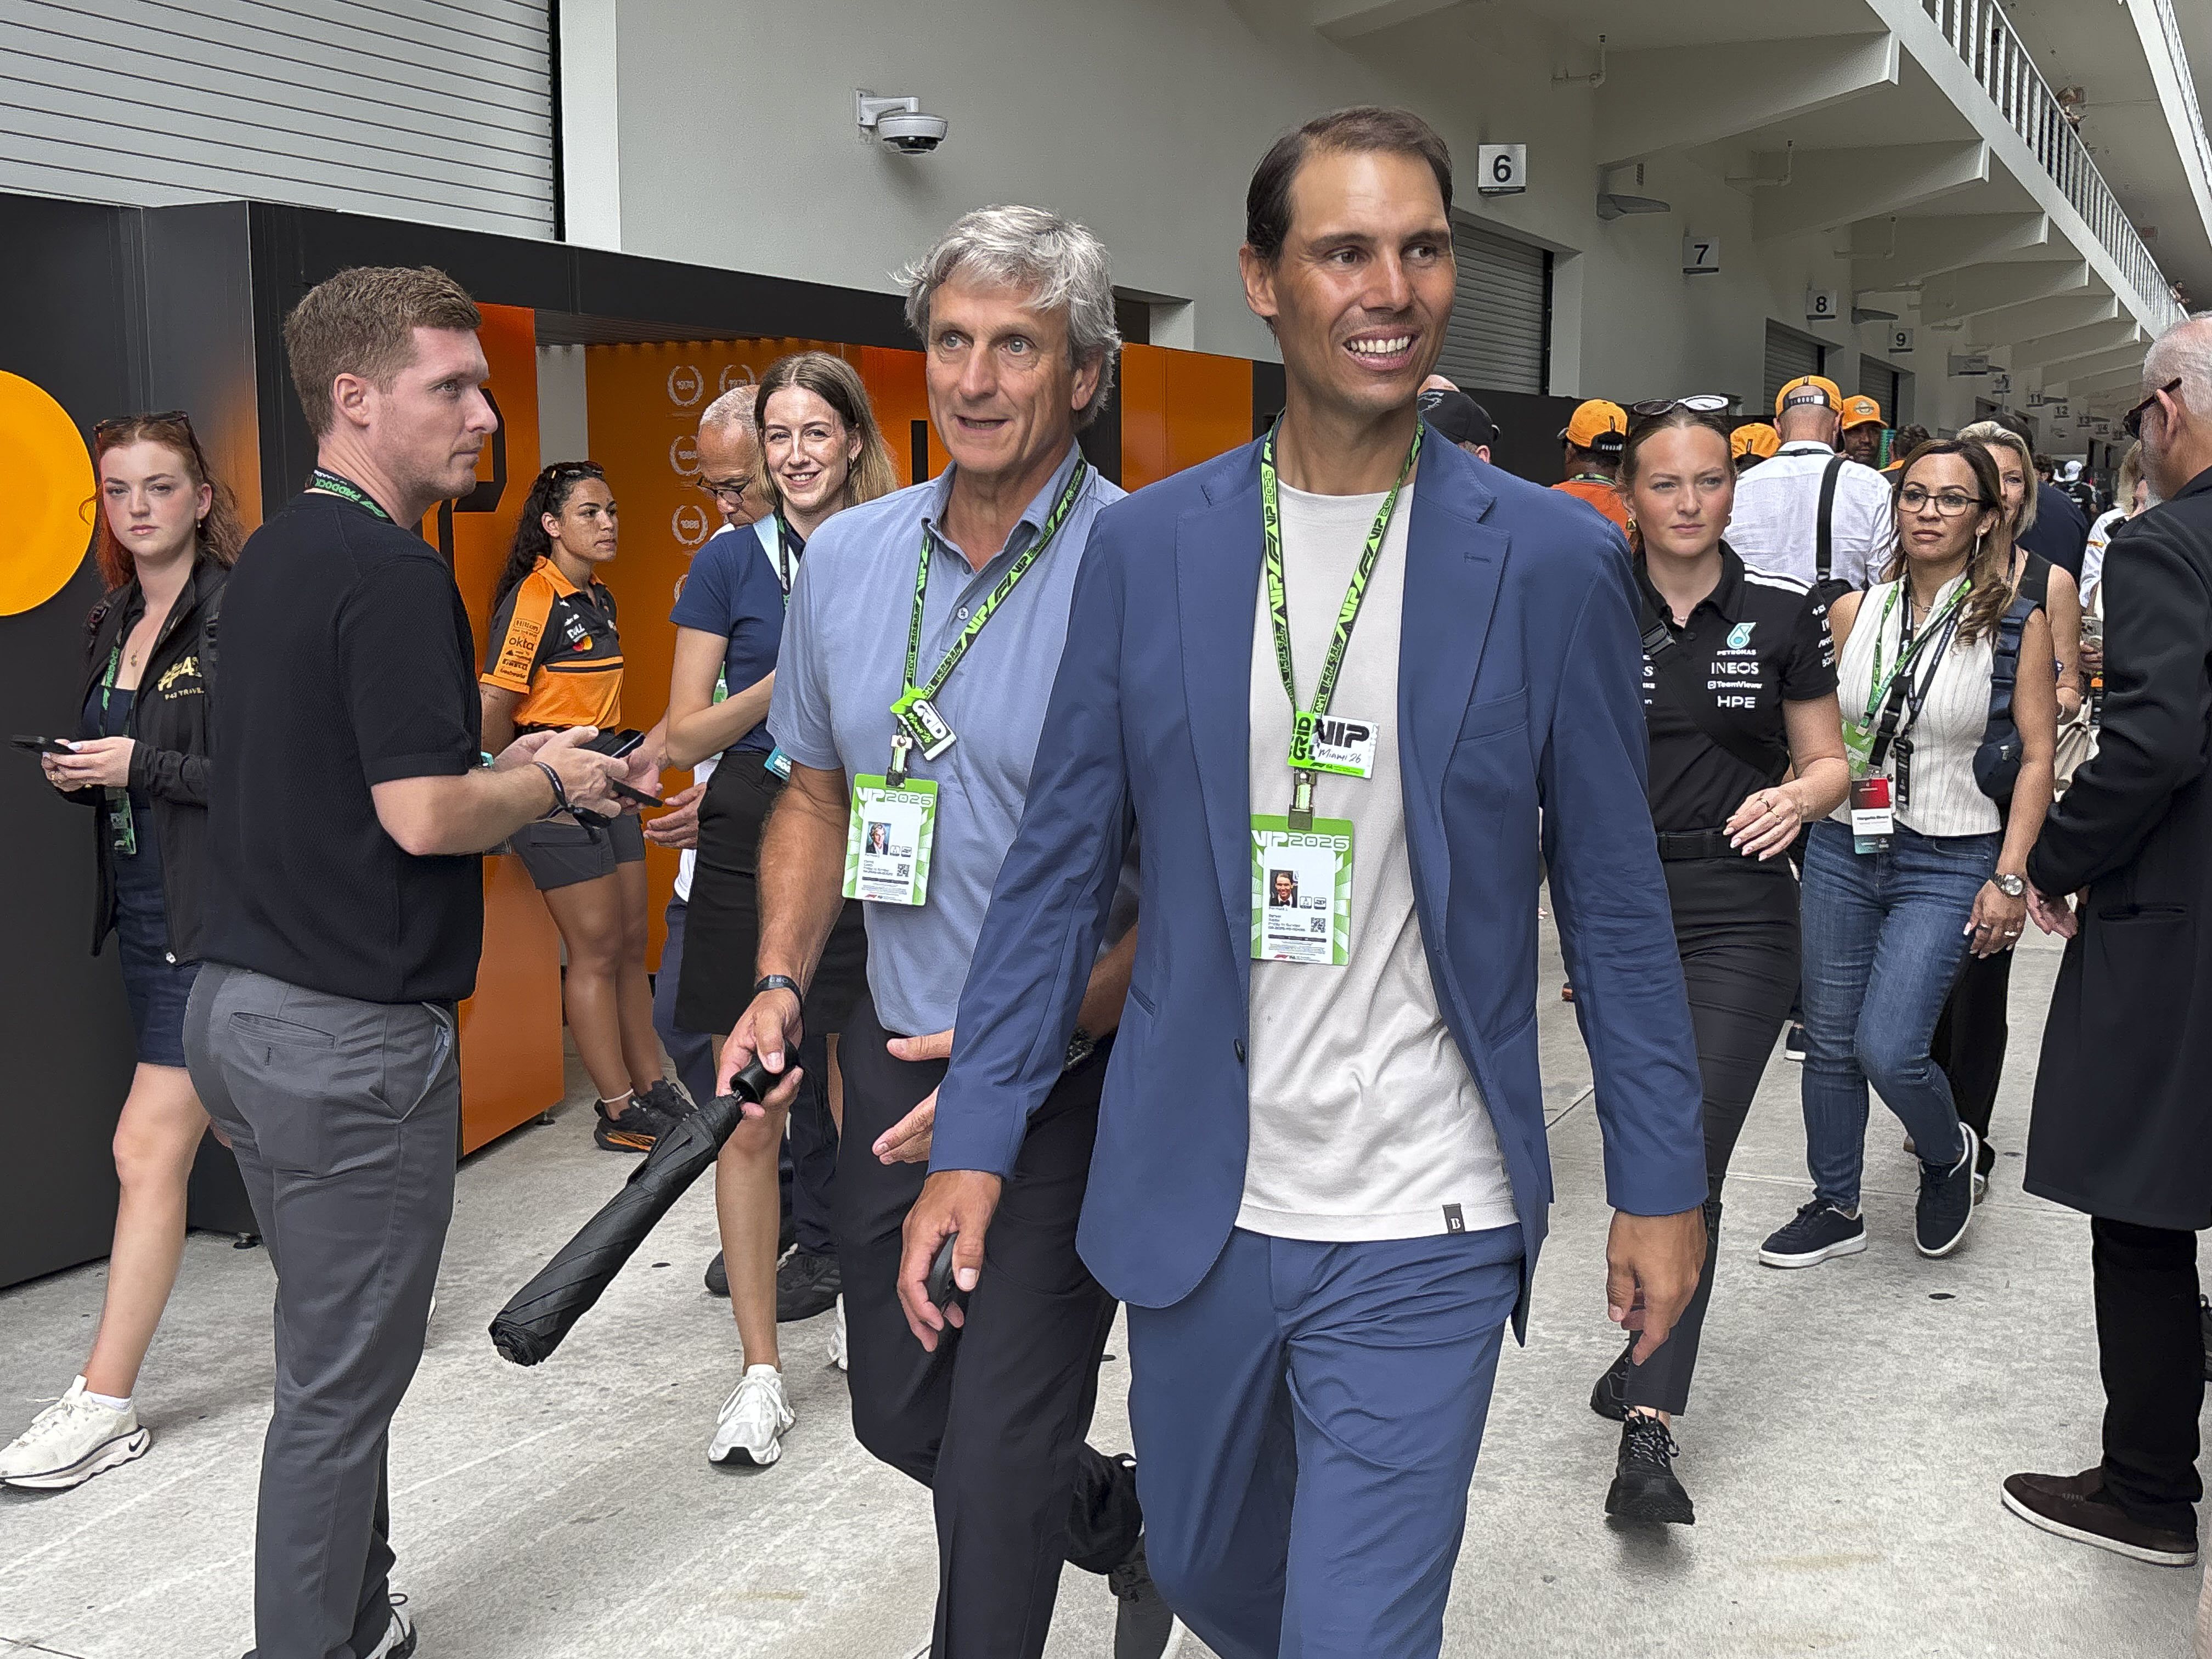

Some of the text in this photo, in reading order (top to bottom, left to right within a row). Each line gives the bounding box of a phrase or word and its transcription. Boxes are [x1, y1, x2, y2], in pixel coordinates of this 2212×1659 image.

[1493, 154, 1511, 183] 6
[1694, 245, 1709, 264] 7
[1816, 296, 1827, 313] 8
[1896, 332, 1906, 347] 9
[2030, 394, 2041, 404] 11
[2056, 407, 2069, 415] 12
[1263, 470, 1276, 504] 2026
[1266, 505, 1277, 528] VIP
[1369, 517, 1384, 540] VIP
[509, 637, 534, 652] okta
[1711, 662, 1759, 675] INEOS
[1717, 695, 1756, 708] HPE
[912, 699, 947, 740] GRID
[1293, 717, 1311, 760] GRID
[1318, 718, 1370, 748] VIP
[1318, 748, 1347, 761] Miami
[1450, 1218, 1461, 1229] B
